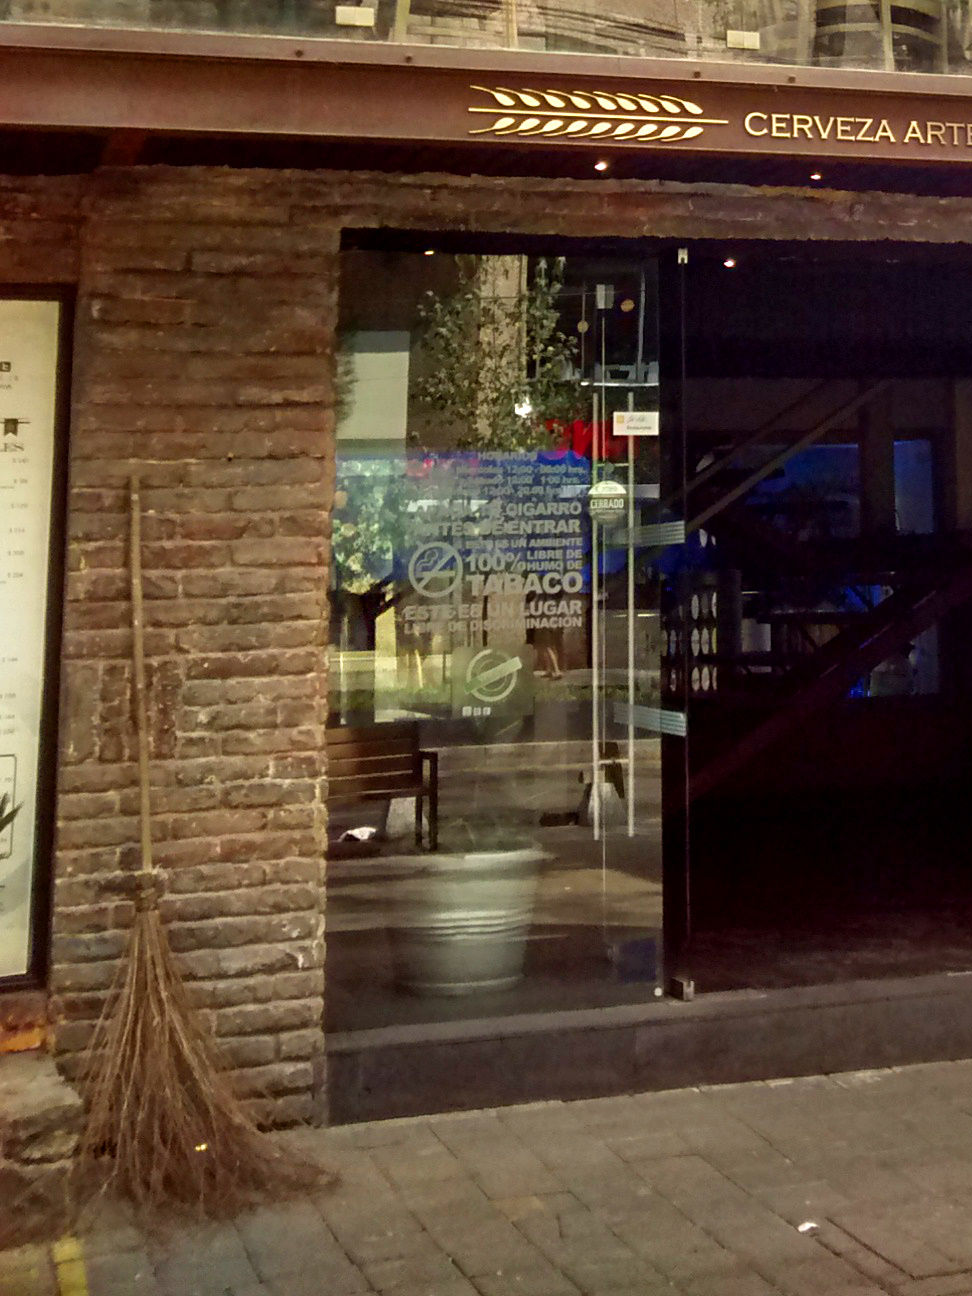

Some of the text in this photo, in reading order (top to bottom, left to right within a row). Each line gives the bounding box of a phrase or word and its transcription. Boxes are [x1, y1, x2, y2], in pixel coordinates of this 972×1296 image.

[744, 111, 894, 144] CERVEZA
[506, 501, 583, 516] CIGARRO
[590, 498, 625, 509] CERRADO
[505, 519, 581, 534] ENTRAR
[528, 537, 583, 548] AMBIENTE
[465, 552, 525, 572] 100%
[527, 549, 583, 561] LIBRE DE
[527, 560, 583, 571] HUMO DE
[465, 571, 583, 596] TABACO
[519, 600, 583, 615] LUGAR
